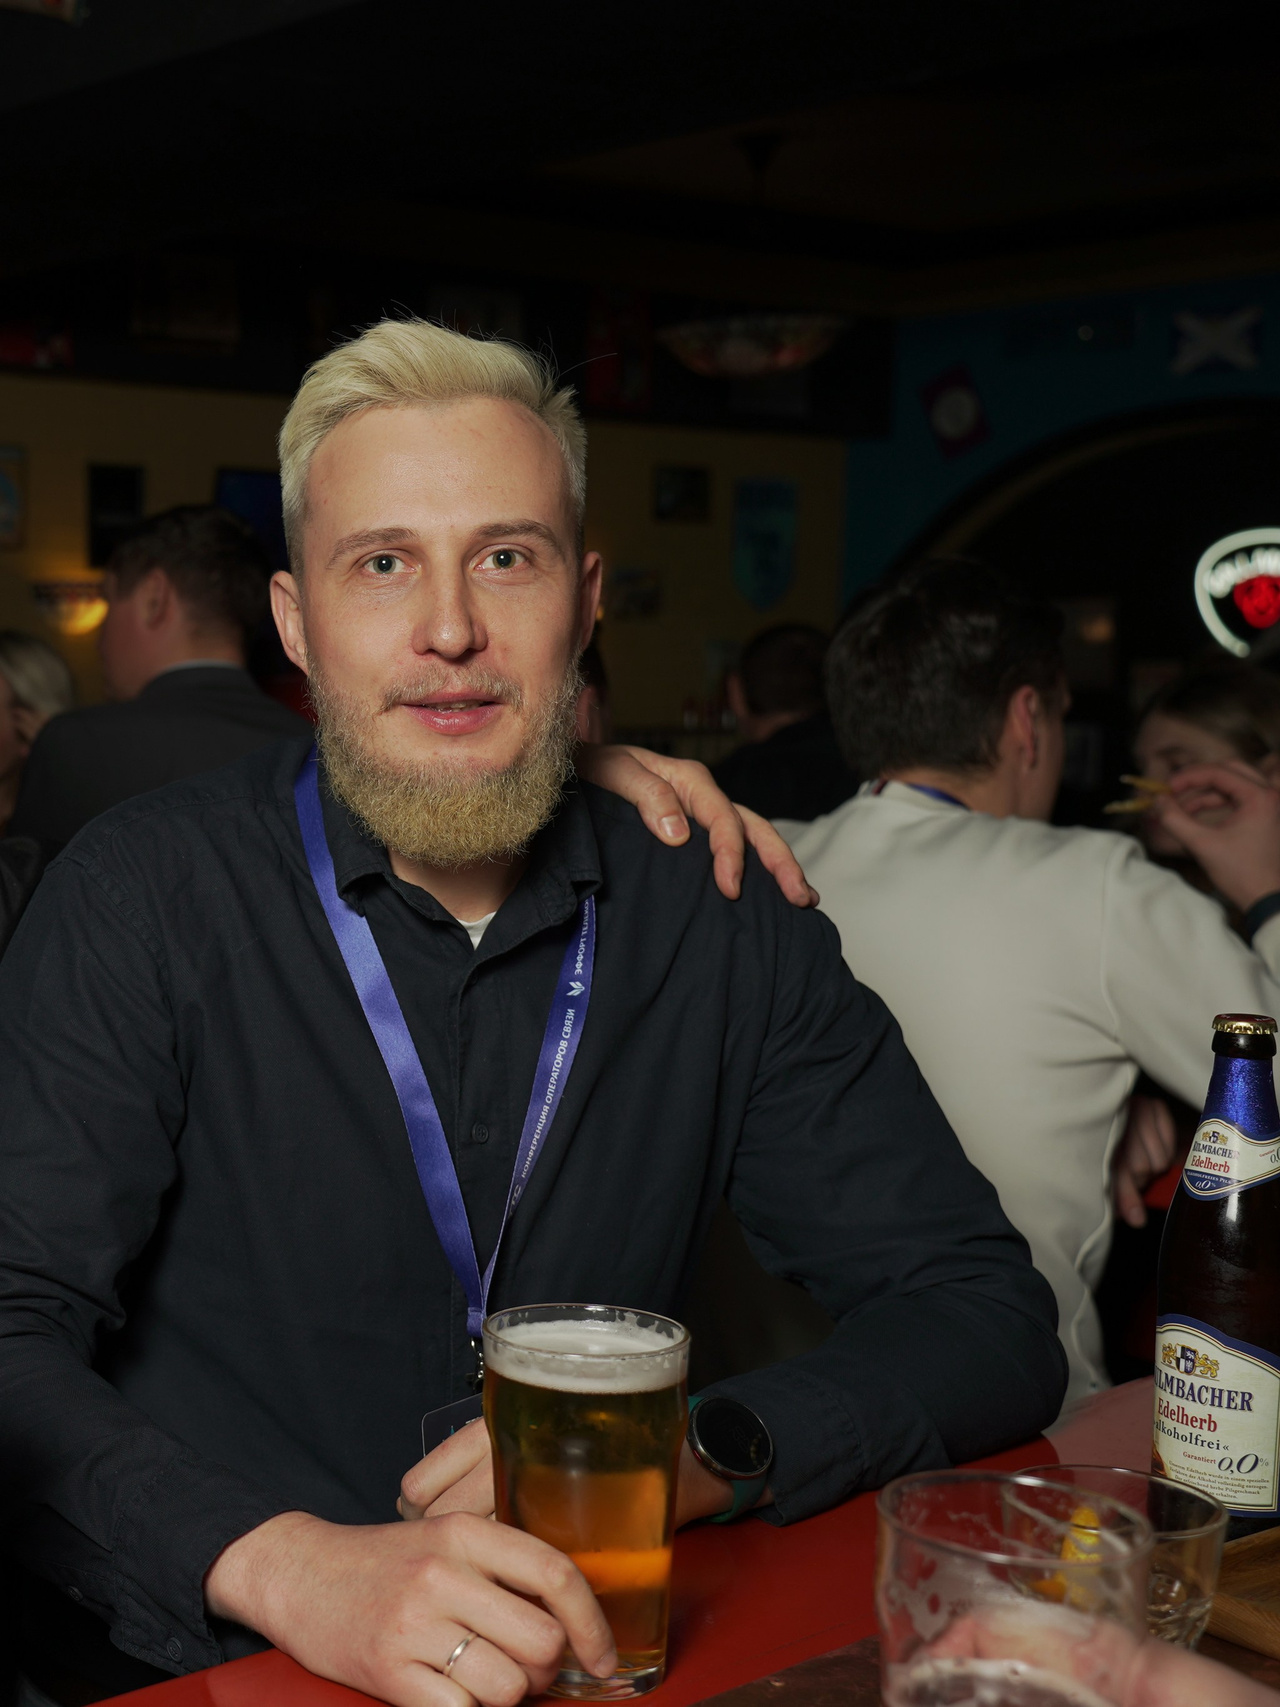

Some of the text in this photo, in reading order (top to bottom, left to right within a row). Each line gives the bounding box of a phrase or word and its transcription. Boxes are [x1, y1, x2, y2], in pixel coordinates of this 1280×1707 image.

[575, 936, 587, 976] ЭФФОРТ
[521, 1105, 550, 1179] КОНФЕРЕНЦИЯ
[545, 1039, 569, 1105] ОПЕРАТОРОВ
[561, 1008, 576, 1040] СВЯЗИ
[1191, 1155, 1230, 1174] Edelherb
[1158, 1398, 1218, 1433] Edelherb
[1183, 1451, 1217, 1465] Garantiert
